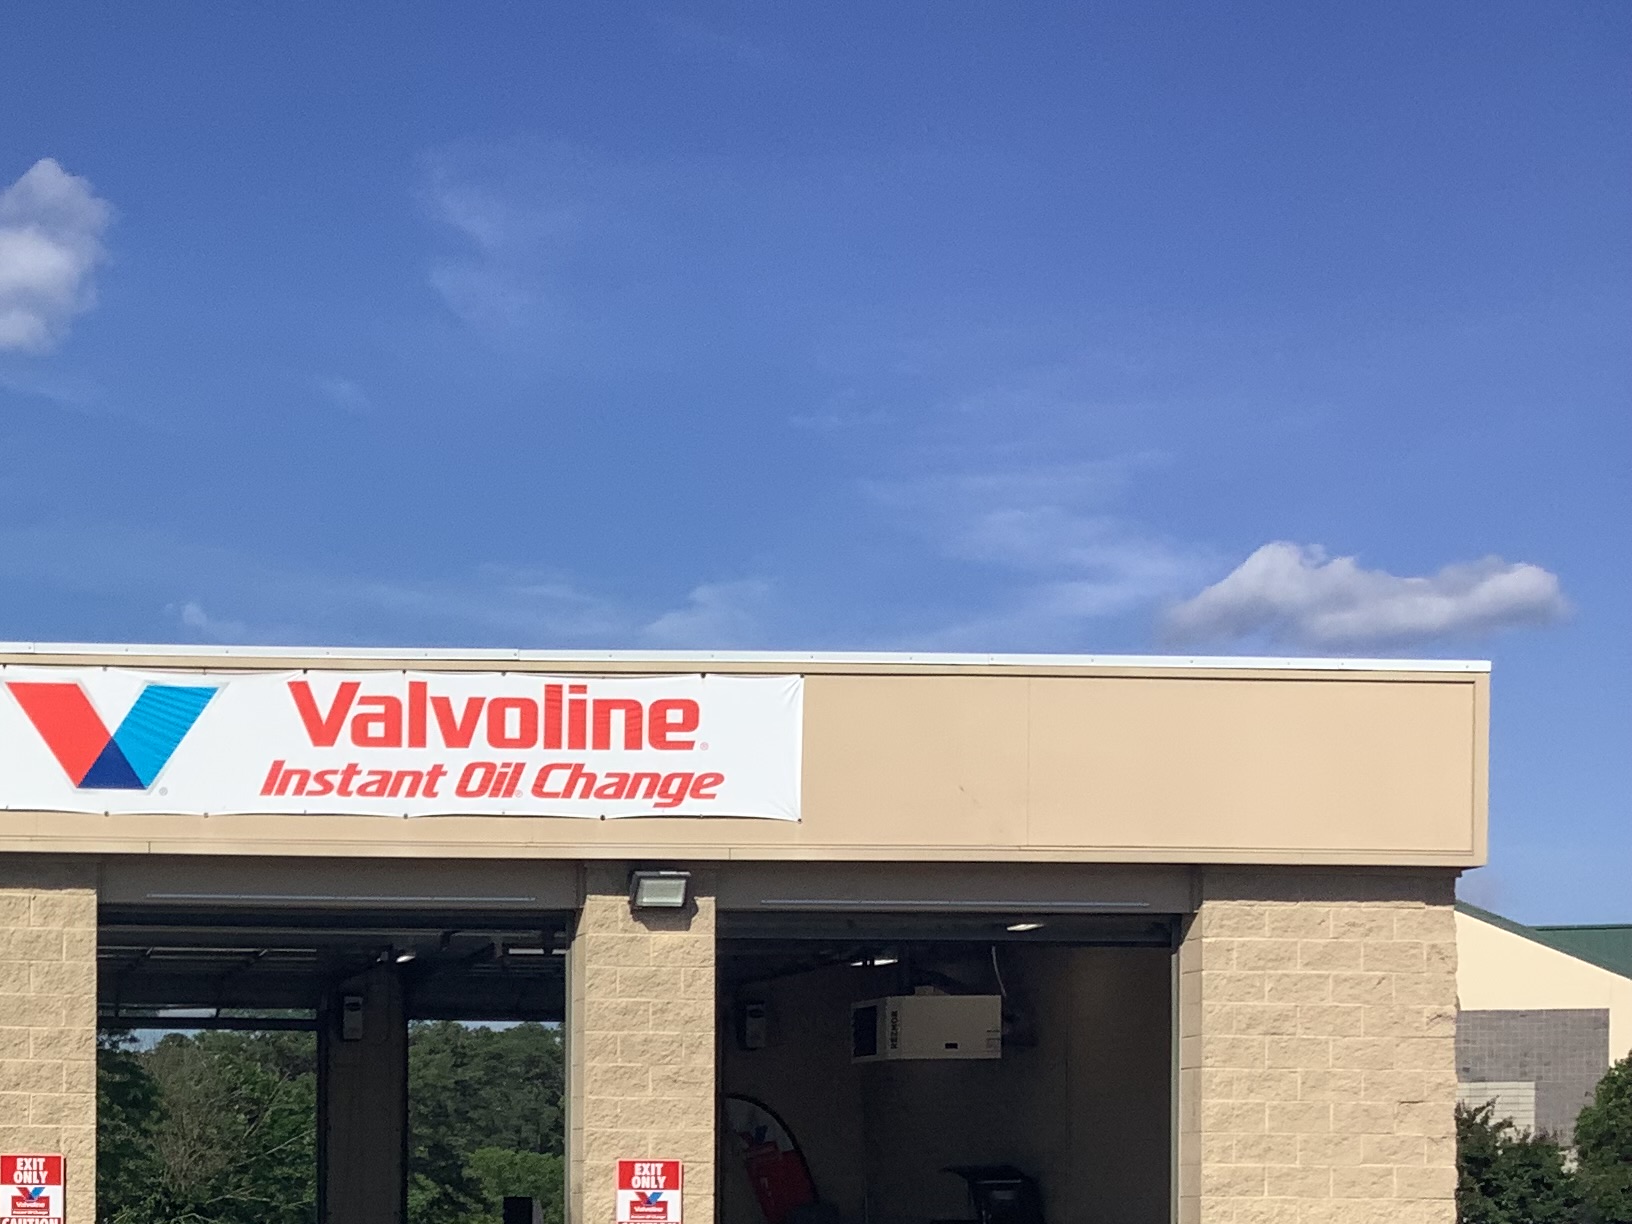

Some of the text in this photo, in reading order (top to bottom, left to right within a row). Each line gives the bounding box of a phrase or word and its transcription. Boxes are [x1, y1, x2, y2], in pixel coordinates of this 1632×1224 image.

[287, 680, 701, 751] Valvoline
[259, 759, 726, 809] Instant Oil Change
[16, 1157, 46, 1171] EXIT
[634, 1162, 664, 1176] EXIT
[13, 1170, 49, 1184] ONLY
[631, 1175, 667, 1189] ONLY
